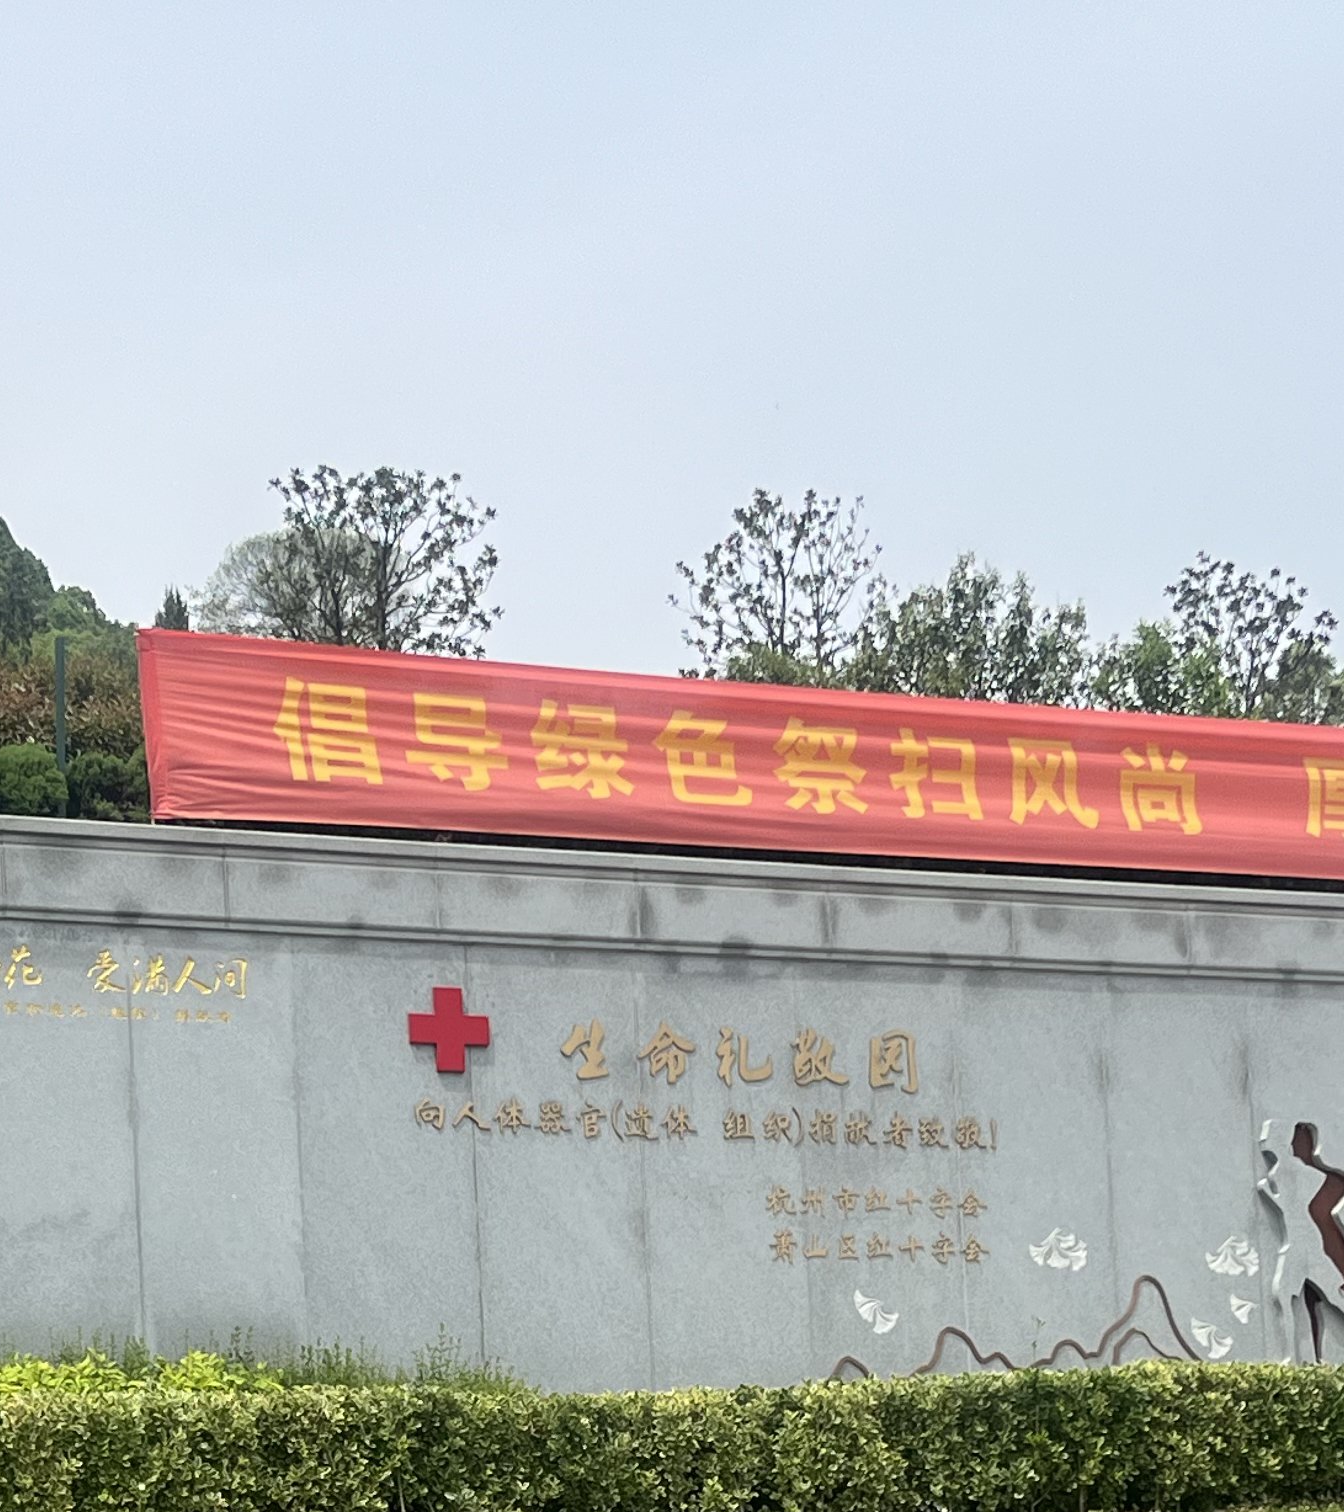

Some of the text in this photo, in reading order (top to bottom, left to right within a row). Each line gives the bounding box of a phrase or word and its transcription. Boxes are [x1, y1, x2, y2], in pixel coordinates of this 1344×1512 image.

[272, 675, 1205, 838] 倡导绿色祭扫风尚
[86, 948, 249, 999] 爱满人间
[560, 1018, 920, 1095] 生命礼敬园
[766, 1184, 988, 1220] 杭州市红十字会
[768, 1226, 990, 1264] 萧山区红十字会
